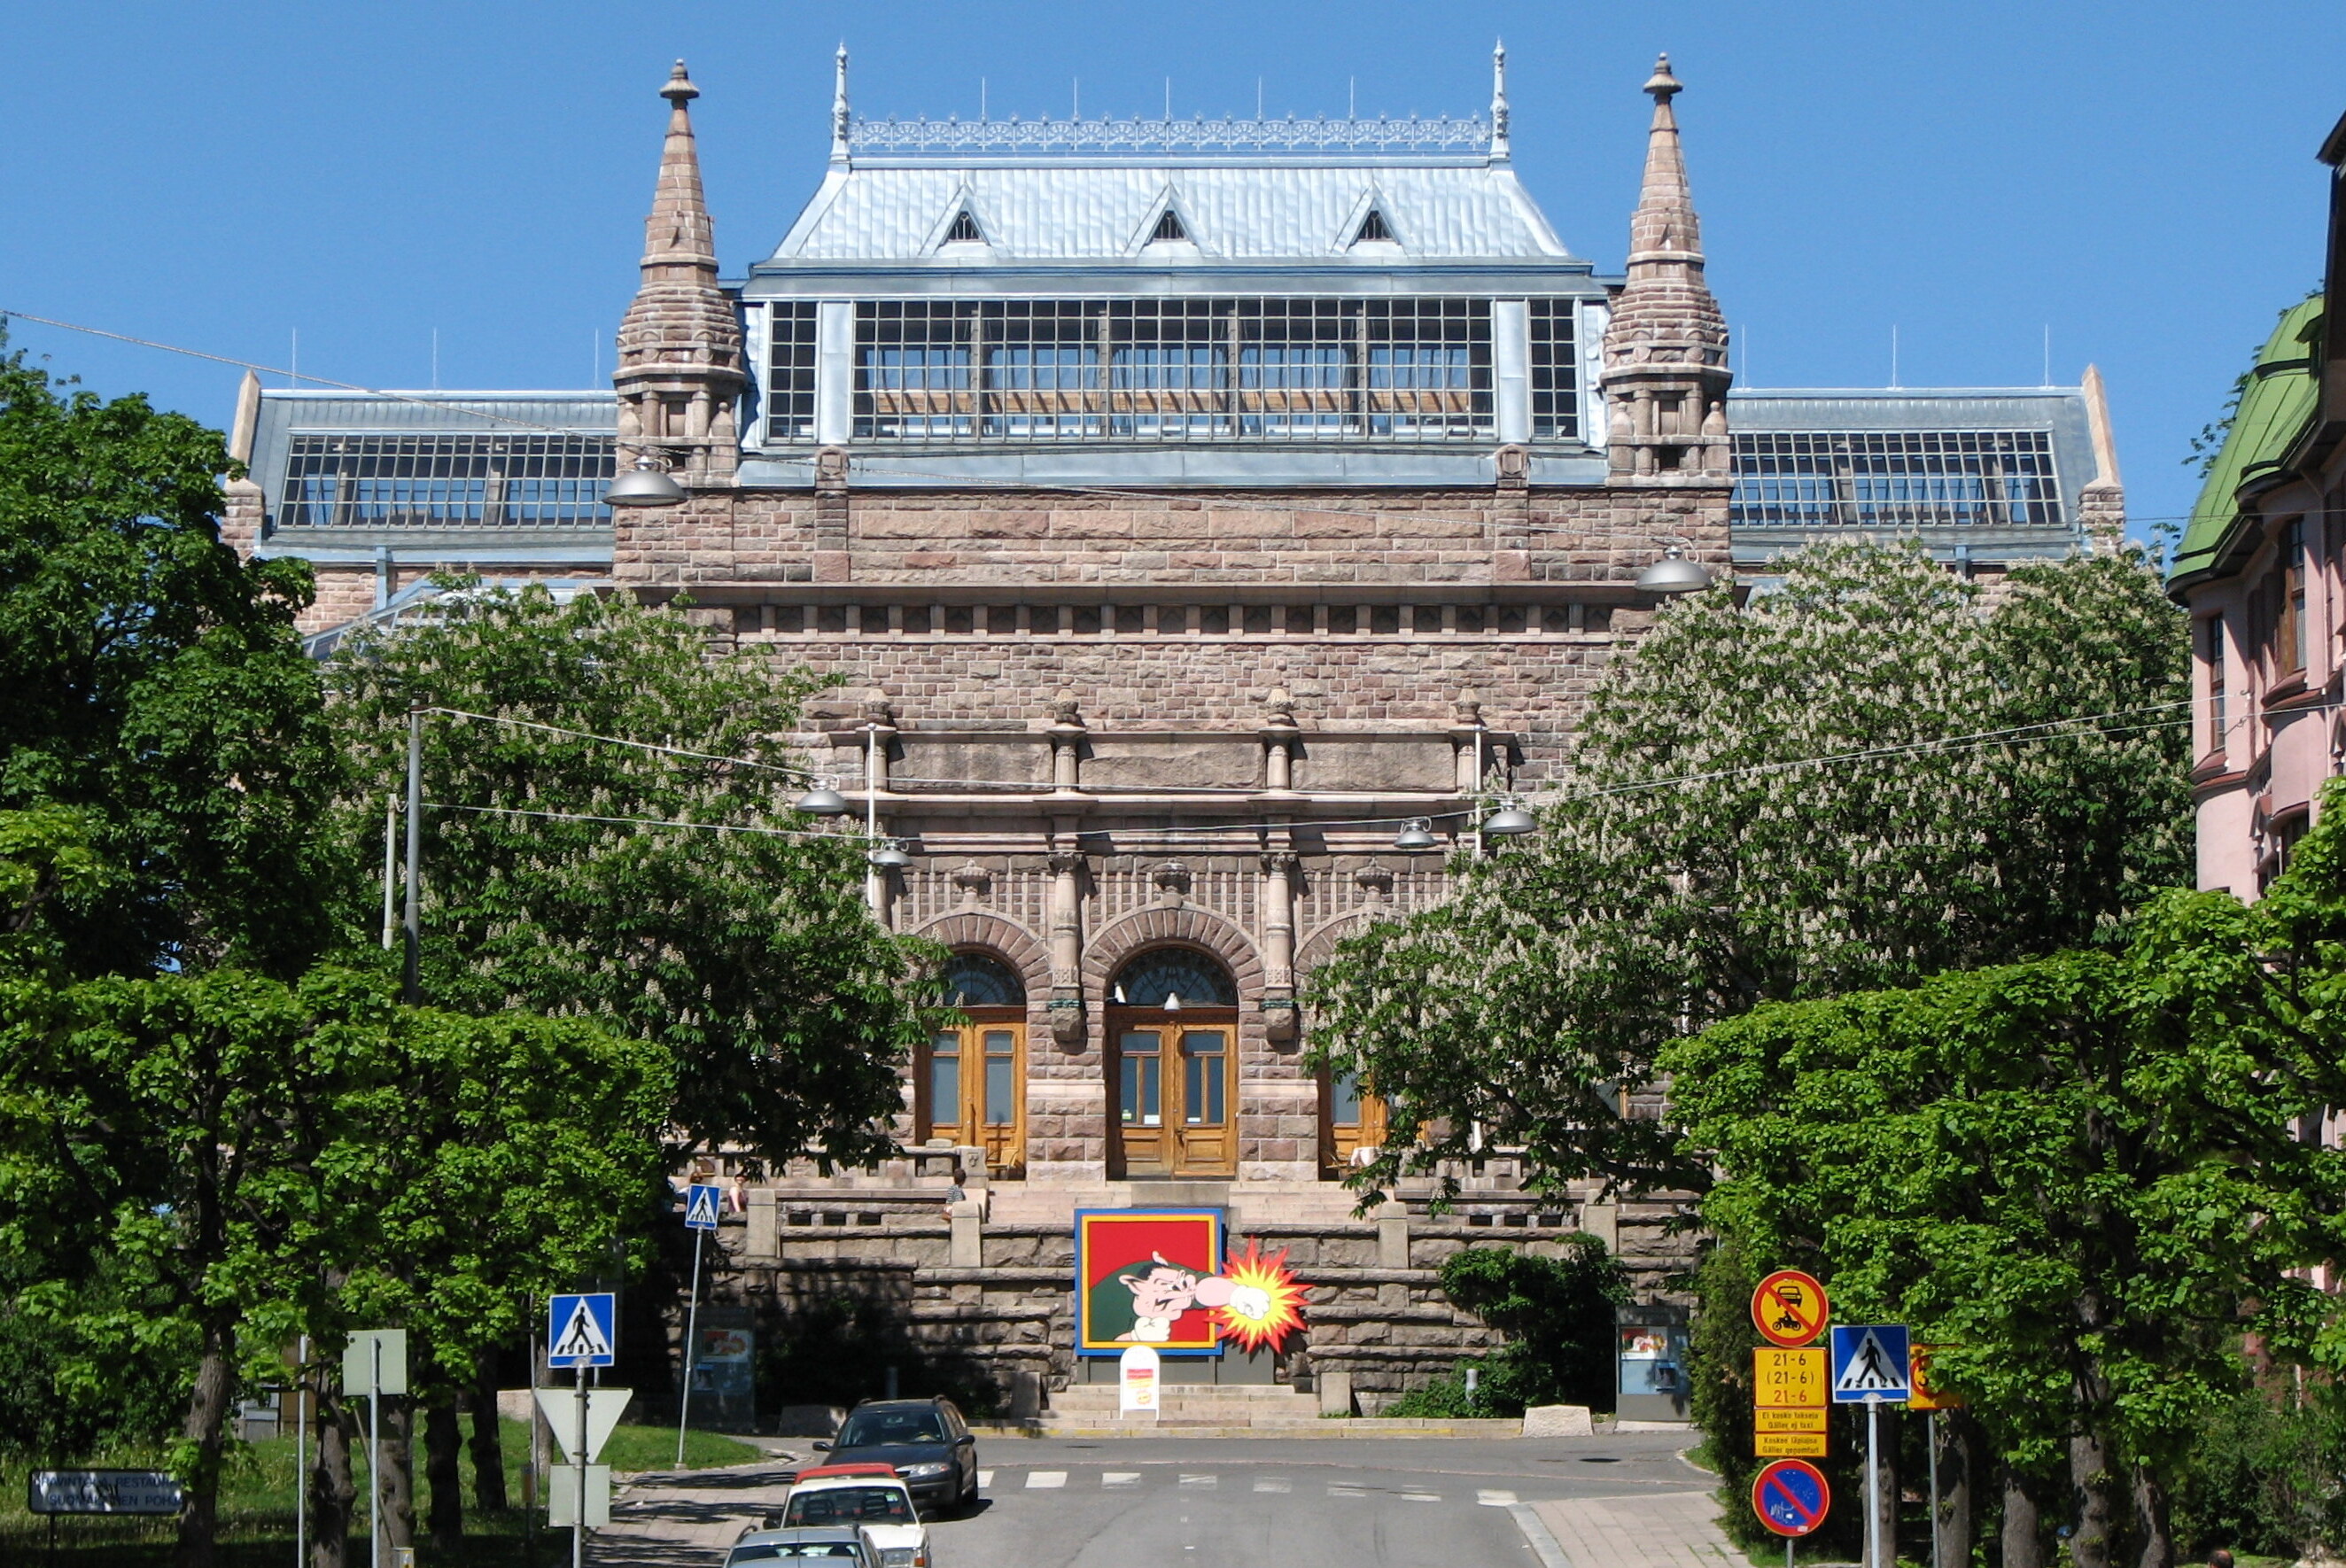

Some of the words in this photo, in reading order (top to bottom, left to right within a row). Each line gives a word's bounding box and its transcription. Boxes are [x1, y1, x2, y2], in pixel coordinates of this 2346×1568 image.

[1773, 1353, 1806, 1366] 21-6
[1767, 1371, 1814, 1385] (21-6)
[1774, 1390, 1807, 1403] 21-6
